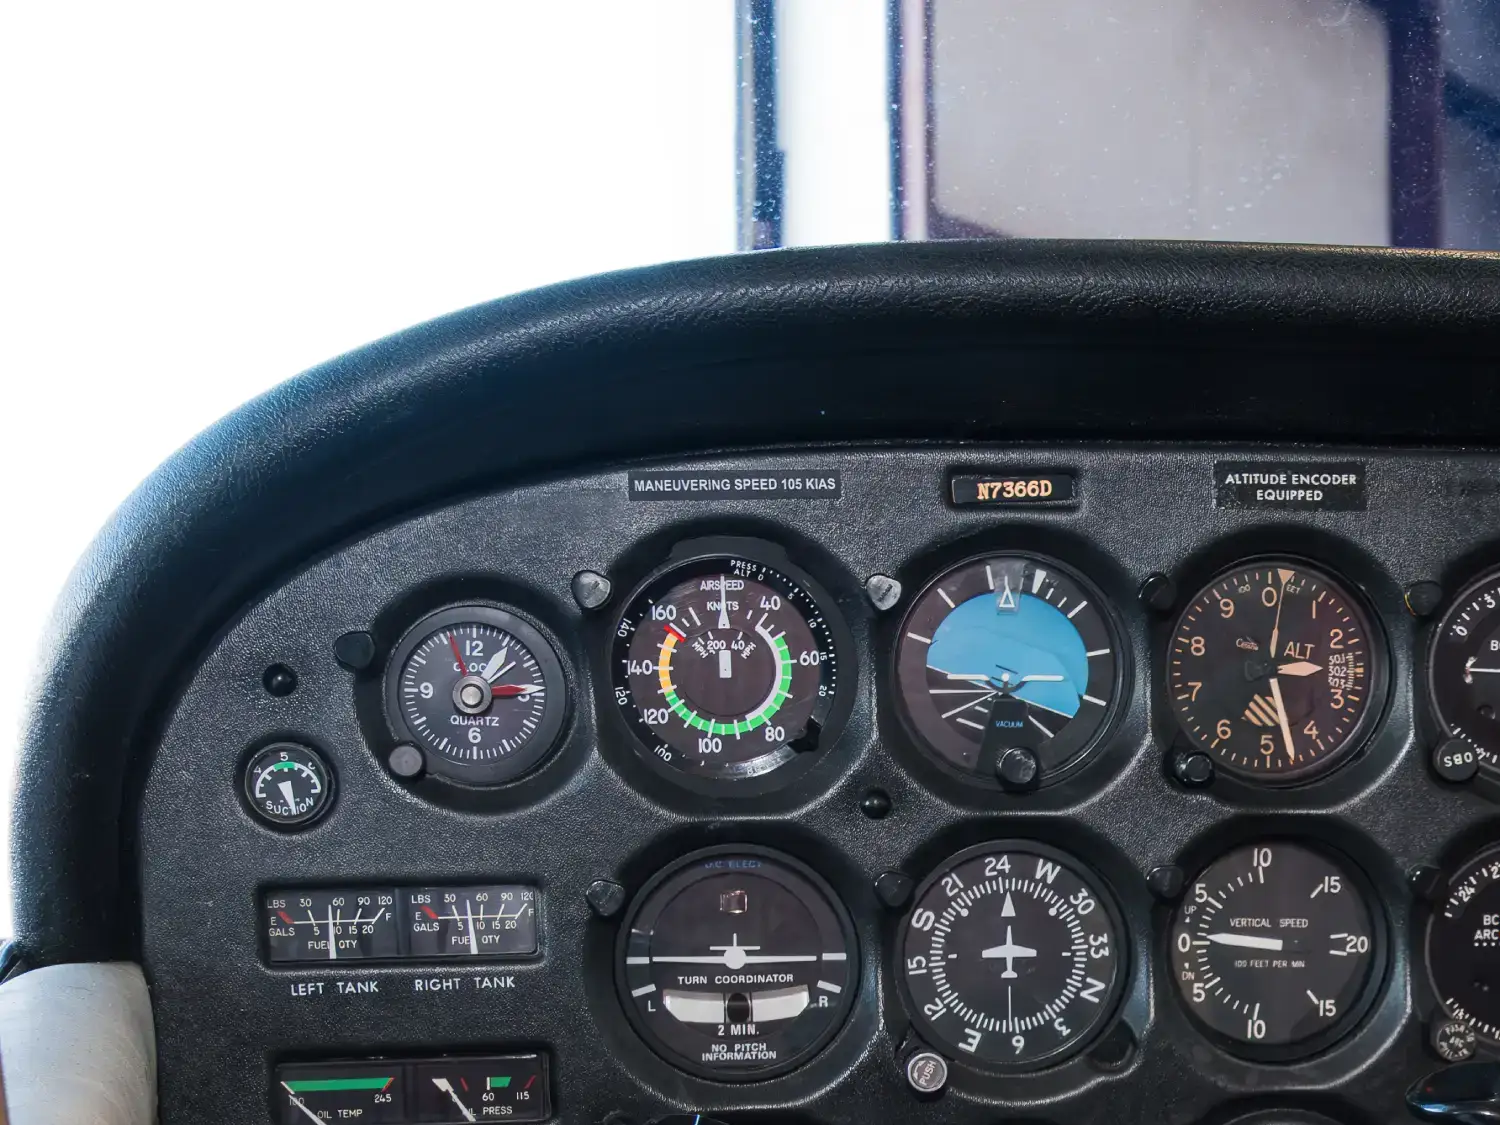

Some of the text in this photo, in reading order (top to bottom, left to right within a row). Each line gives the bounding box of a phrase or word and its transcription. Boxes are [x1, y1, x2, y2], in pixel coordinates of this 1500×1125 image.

[634, 478, 836, 492] MANEUVERING SPEED 105 KIAS
[1225, 473, 1357, 487] ALTITUDE ENCODER
[977, 481, 1052, 499] N7366D
[1256, 489, 1323, 501] EQUIPPED
[730, 559, 756, 572] PRESS
[734, 569, 751, 578] ALT
[700, 580, 745, 591] AIRSEED
[707, 601, 739, 611] KNTS
[652, 605, 677, 620] 160
[1284, 641, 1315, 659] ALT
[450, 716, 500, 727] QUARTZ
[698, 738, 722, 753] 100
[1252, 848, 1272, 867] 10
[984, 855, 1011, 877] 24
[411, 895, 431, 904] LBS
[413, 923, 440, 932] GALS
[1230, 918, 1309, 928] VERTICAL SPEED
[268, 927, 296, 937] GALS
[1474, 930, 1499, 940] ARC
[481, 934, 500, 944] QTY
[1346, 936, 1368, 953] 20
[1250, 960, 1269, 968] FEET
[414, 976, 516, 991] RIGHT TANK
[677, 973, 794, 985] TURN COORDINATOR
[290, 981, 379, 996] LEFT TANK
[717, 1024, 760, 1036] 2 MIN.
[1247, 1019, 1266, 1038] 10
[711, 1043, 767, 1053] NO PITCH
[701, 1051, 777, 1062] INFORMATION
[919, 1060, 937, 1086] PUSH
[316, 1109, 363, 1119] OIL TEMP
[482, 1106, 513, 1115] PRESS
